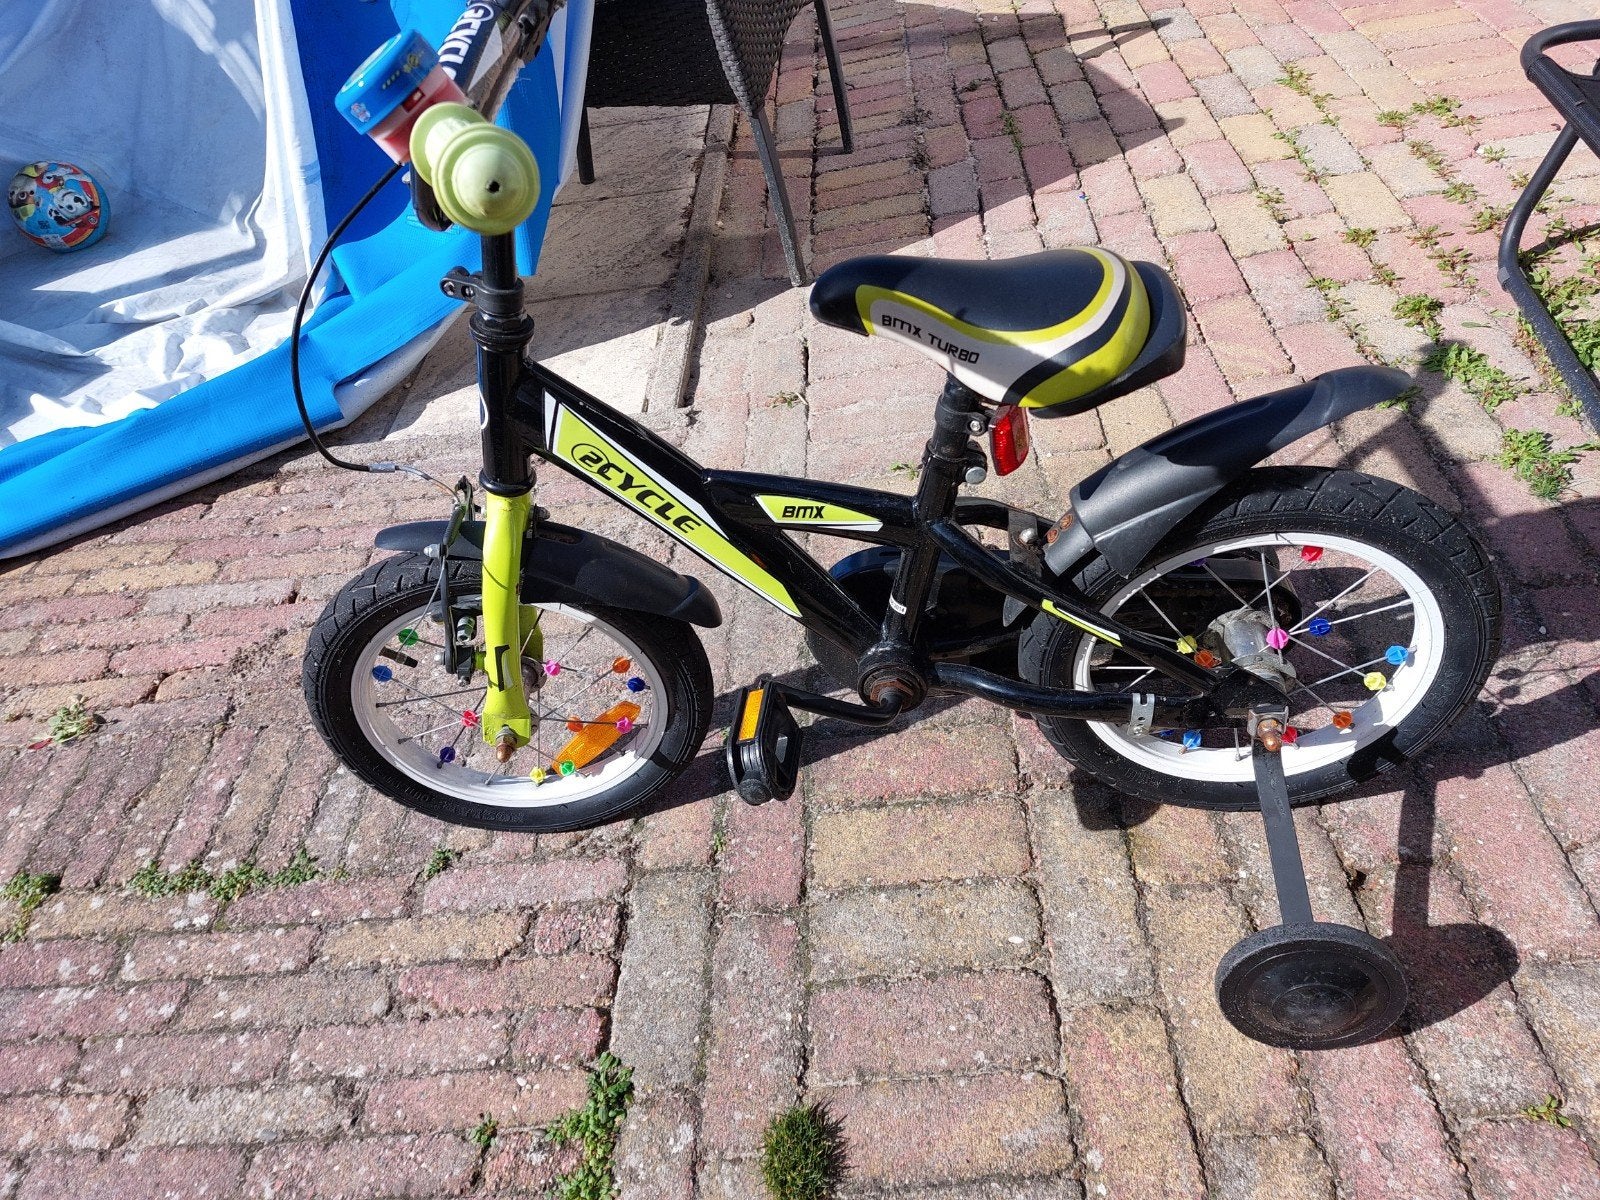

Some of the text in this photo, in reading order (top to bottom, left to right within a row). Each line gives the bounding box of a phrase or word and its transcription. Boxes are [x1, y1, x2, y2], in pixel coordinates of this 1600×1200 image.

[881, 314, 981, 365] BMX TURBO
[571, 443, 702, 534] 2CYCLE
[781, 505, 826, 519] BMX
